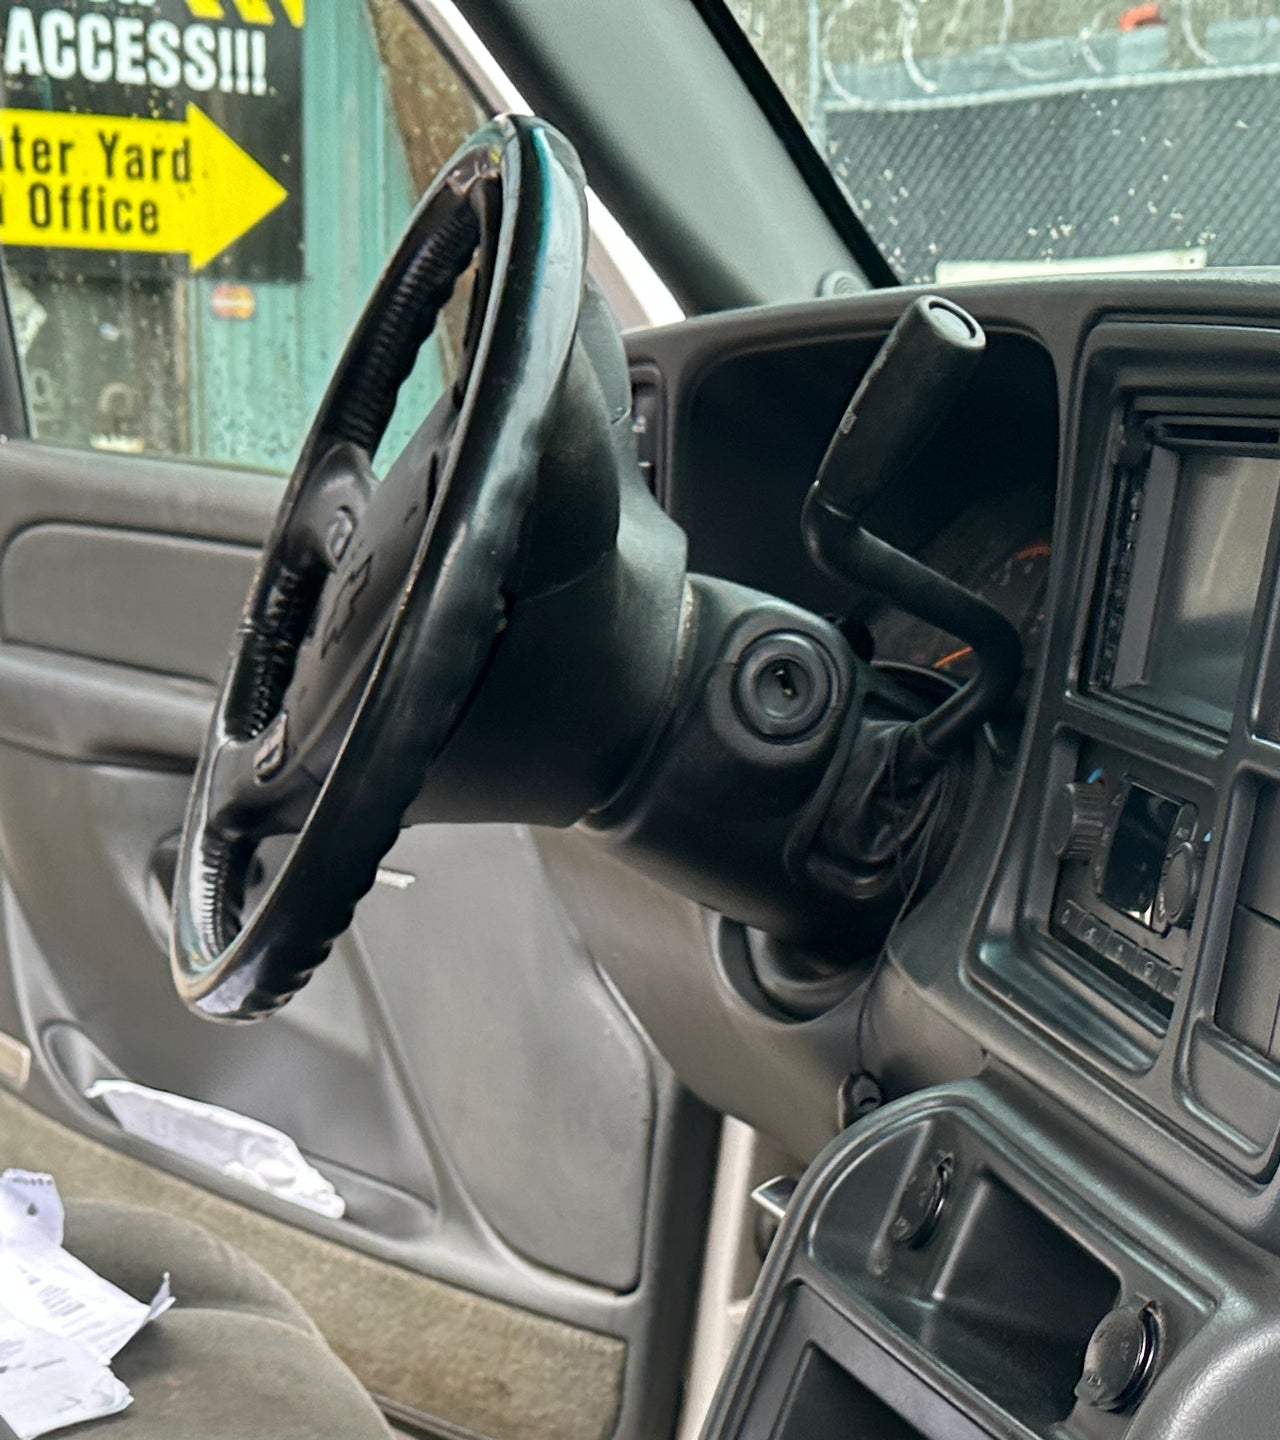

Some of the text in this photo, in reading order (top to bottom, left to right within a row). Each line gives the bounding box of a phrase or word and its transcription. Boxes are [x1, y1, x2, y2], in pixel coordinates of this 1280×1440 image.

[3, 6, 267, 96] ACCESS!!!
[98, 131, 191, 183] Yard
[29, 182, 159, 235] Office
